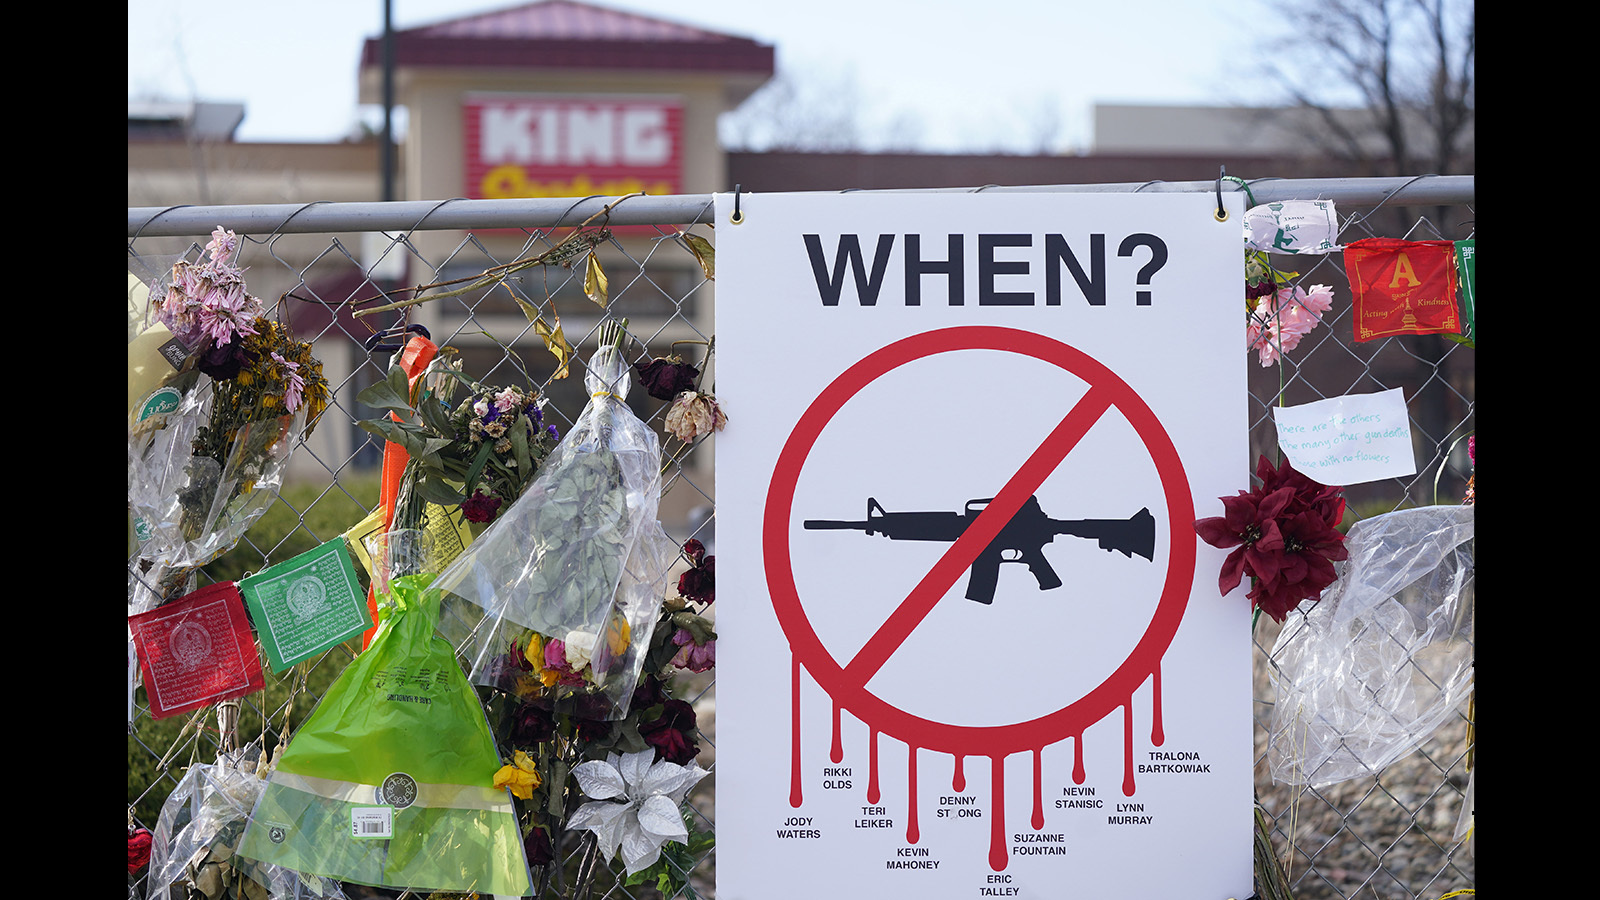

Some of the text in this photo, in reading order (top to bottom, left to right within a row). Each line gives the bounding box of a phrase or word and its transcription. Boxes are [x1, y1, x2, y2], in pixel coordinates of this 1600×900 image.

[480, 107, 673, 166] KING
[802, 232, 1169, 307] WHEN?
[1388, 252, 1422, 288] A
[1363, 310, 1388, 319] Acting
[1417, 297, 1449, 306] Kindness
[1277, 414, 1381, 433] There are te others
[1280, 439, 1298, 450] The
[1301, 440, 1331, 449] many
[1333, 432, 1359, 444] other
[1319, 455, 1340, 467] with
[1354, 450, 1390, 464] flowers
[1148, 751, 1200, 761] TRALONA
[823, 767, 852, 777] RIKKI
[1138, 764, 1211, 774] BARTKOWIAK
[823, 780, 853, 790] OLDS
[1063, 787, 1095, 797] NEVIN
[939, 796, 977, 806] DENNY
[1055, 799, 1103, 809] STANISIC
[861, 806, 886, 816] TERI
[936, 808, 982, 818] STONG
[1116, 803, 1144, 813] LYNN
[784, 817, 813, 827] JODY
[854, 819, 893, 829] LEIKER
[1108, 815, 1153, 825] MURRAY
[776, 829, 821, 839] WATERS
[1014, 833, 1065, 843] SUZANNE
[897, 848, 929, 858] KEVIN
[1013, 846, 1066, 856] FOUNTAIN
[886, 860, 940, 870] MAHONEY
[987, 874, 1012, 884] ERIC
[979, 887, 1020, 897] TALLEY
